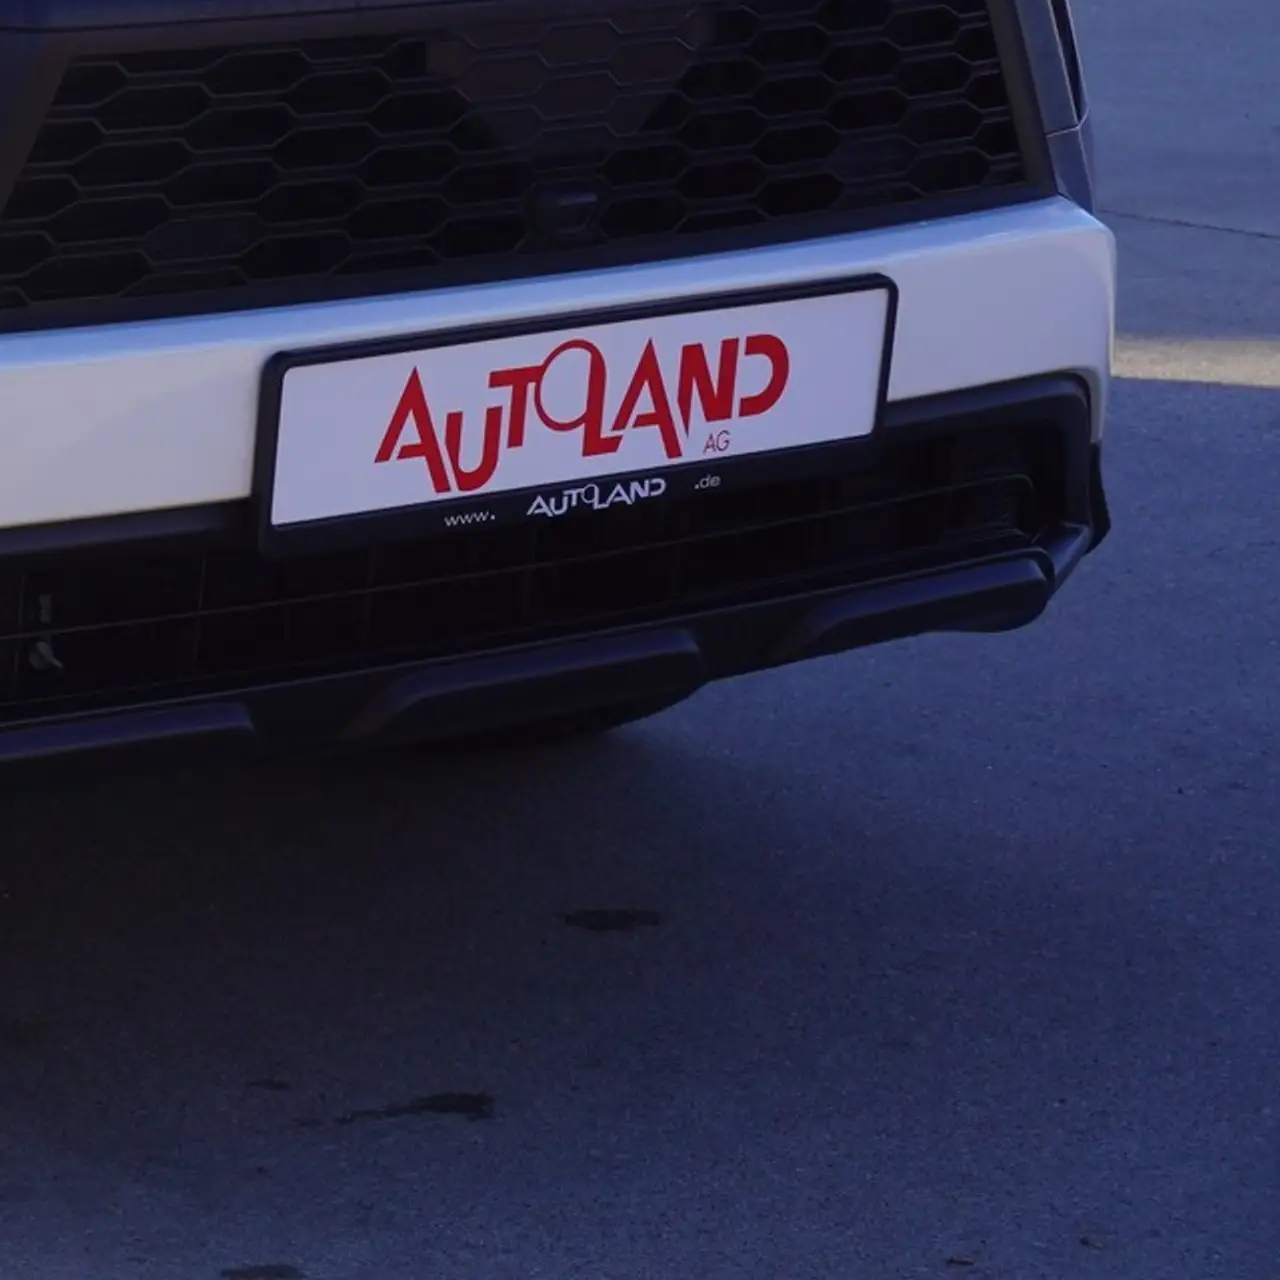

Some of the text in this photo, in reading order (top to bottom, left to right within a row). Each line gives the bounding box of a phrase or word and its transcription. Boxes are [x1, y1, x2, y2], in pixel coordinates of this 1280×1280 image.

[374, 334, 790, 494] AUTOLAND
[703, 429, 732, 455] AG
[444, 474, 721, 527] www. AUTOLAND .de
